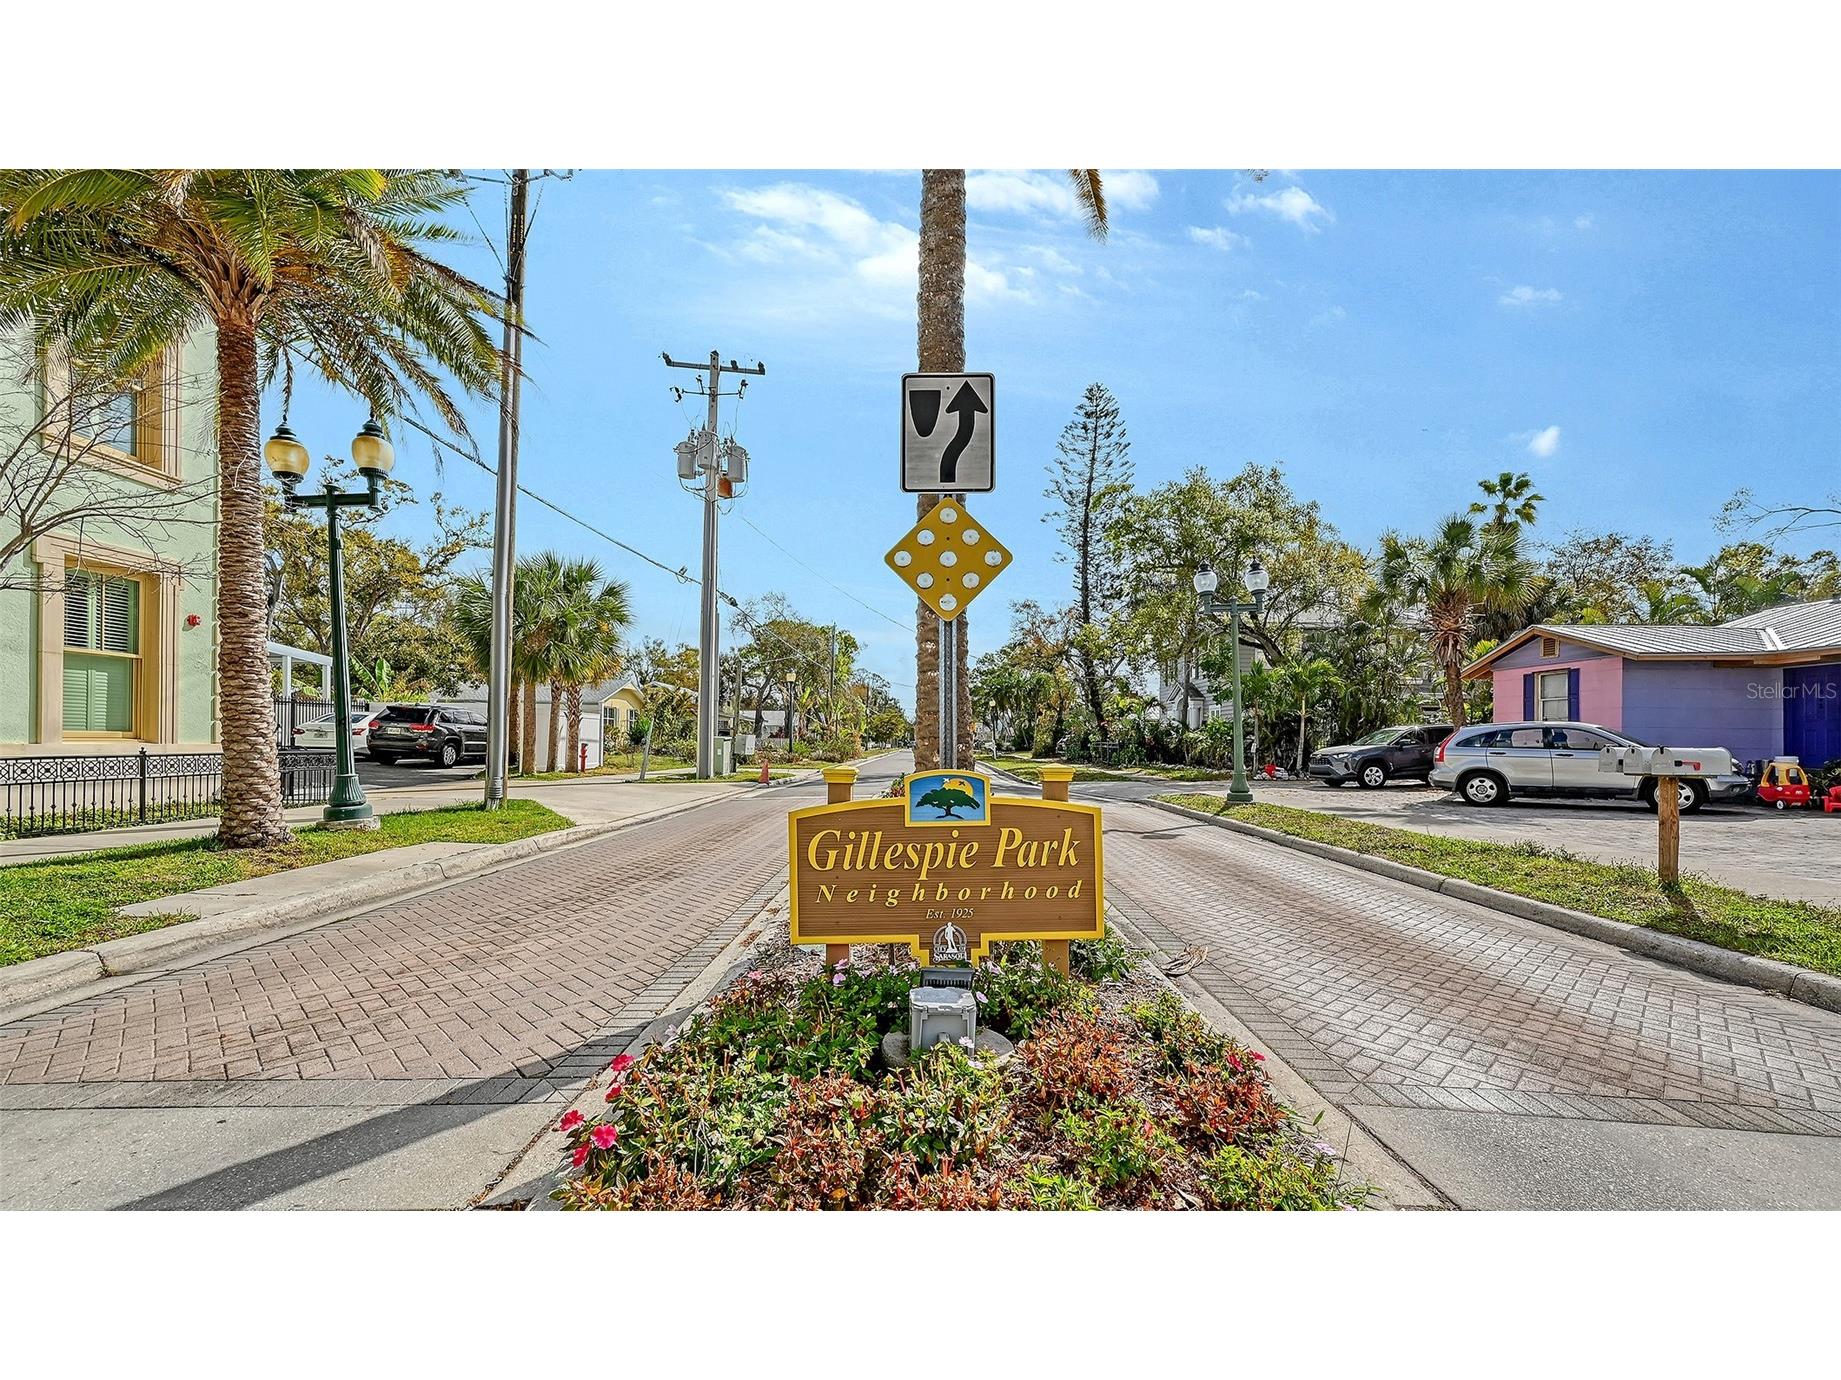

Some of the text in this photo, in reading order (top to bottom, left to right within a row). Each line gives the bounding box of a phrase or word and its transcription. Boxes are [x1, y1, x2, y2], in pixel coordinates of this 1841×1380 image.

[807, 827, 1082, 880] Gillespie Park
[815, 880, 1082, 907] Neighborhood
[925, 907, 974, 919] Est. 1925
